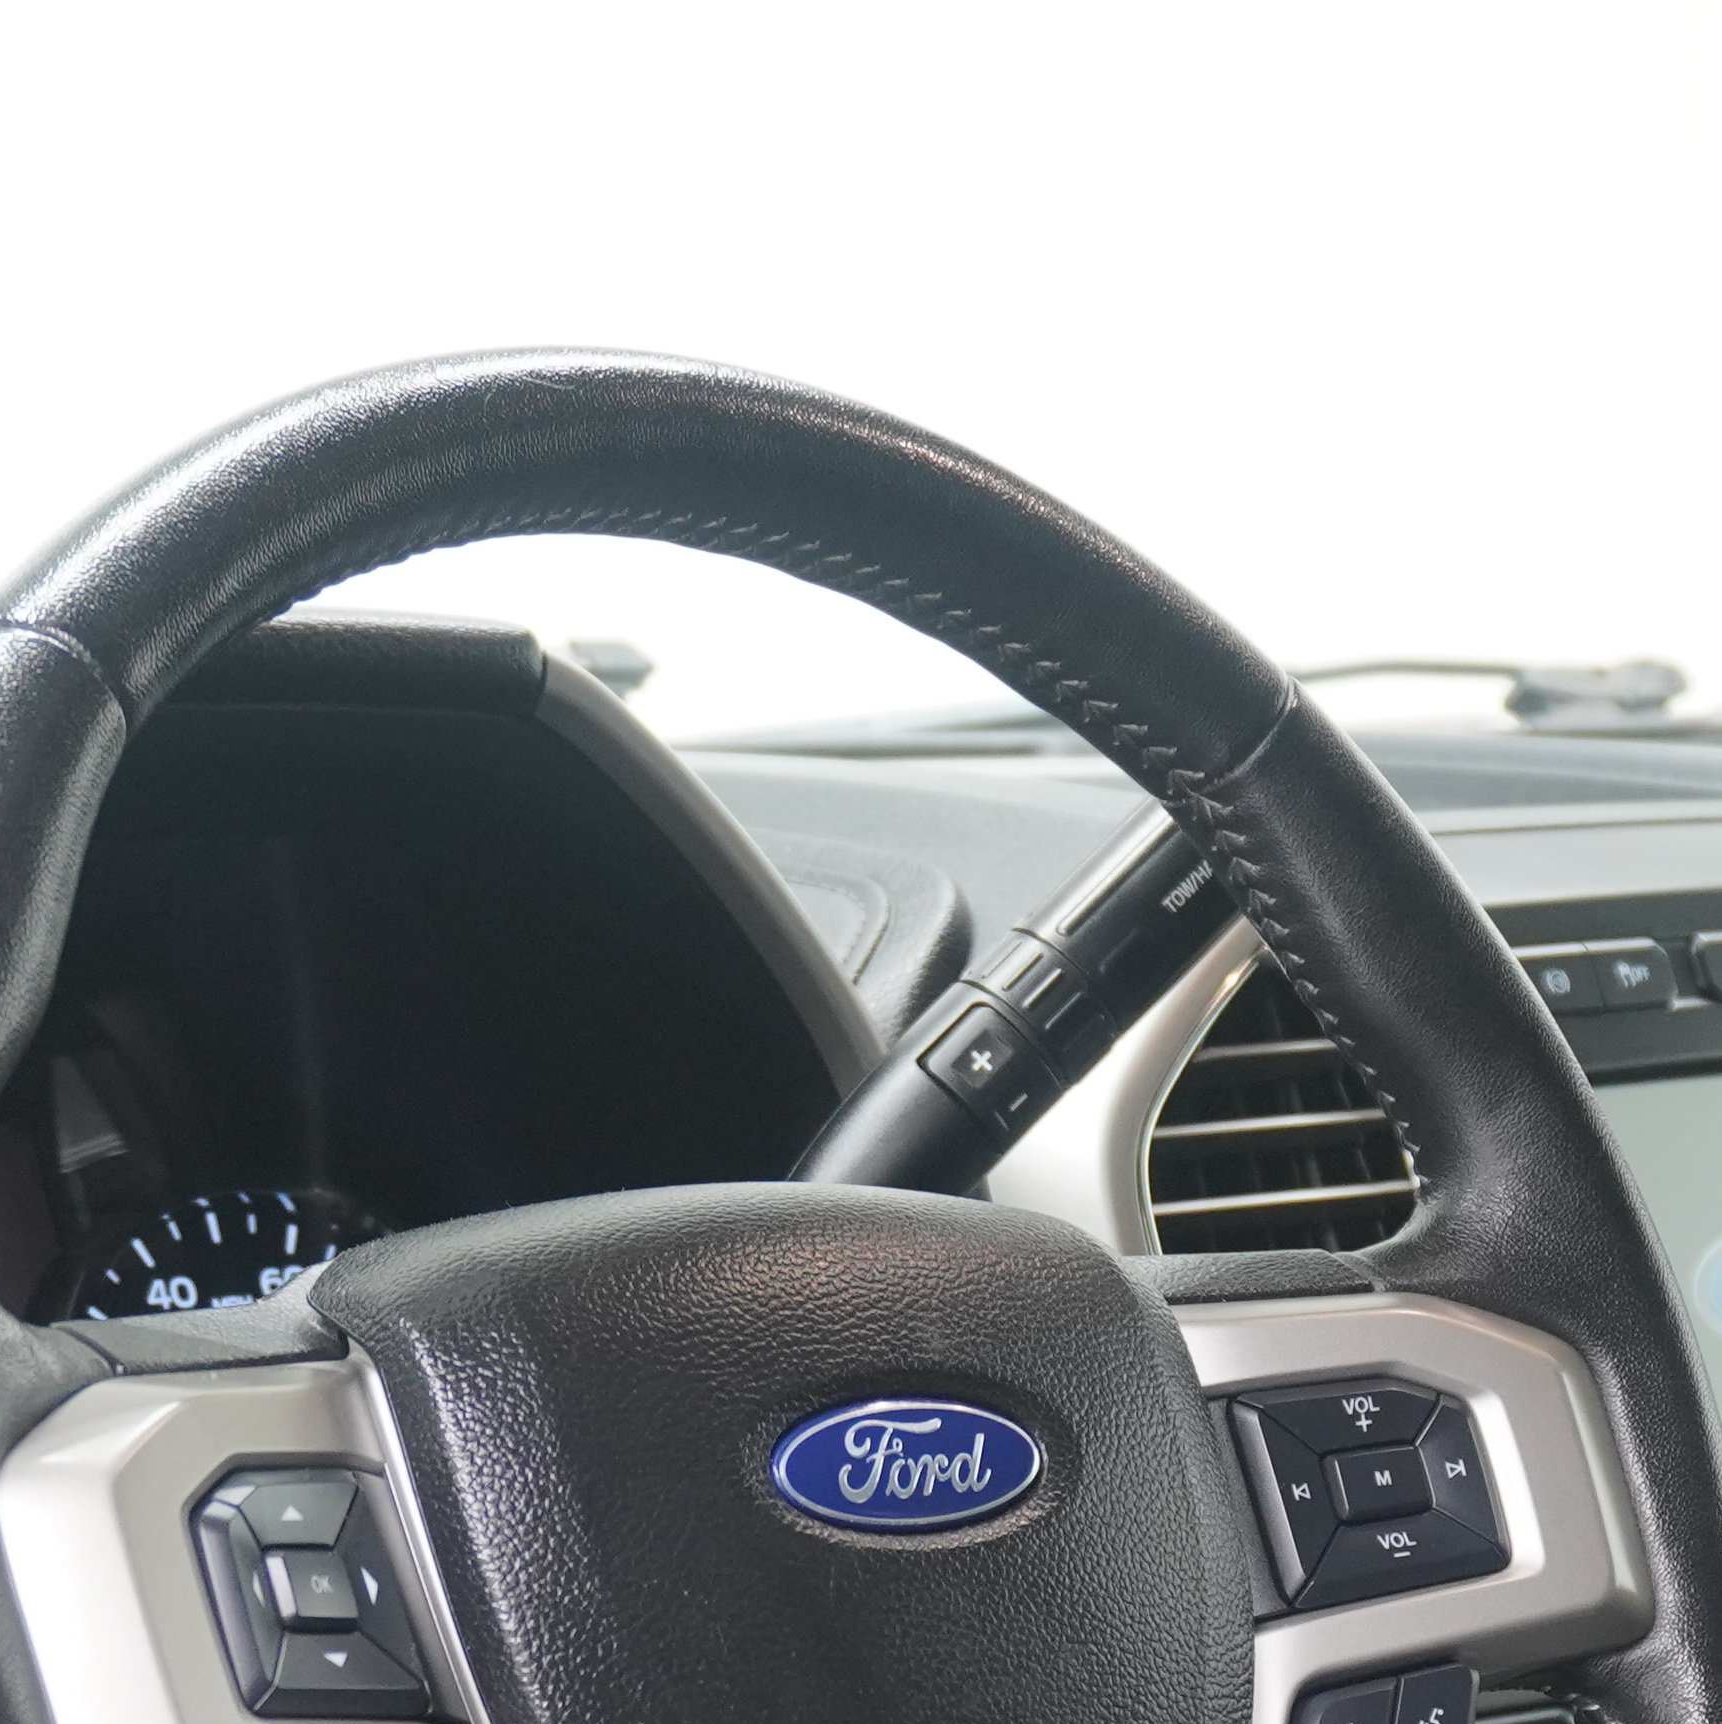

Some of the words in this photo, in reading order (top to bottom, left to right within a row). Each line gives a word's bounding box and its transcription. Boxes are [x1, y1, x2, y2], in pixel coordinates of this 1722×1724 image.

[146, 1276, 198, 1311] 40
[1342, 1396, 1381, 1415] VOL
[838, 1418, 992, 1504] Ford
[1374, 1470, 1393, 1487] M
[1377, 1531, 1418, 1550] VOL
[310, 1574, 333, 1594] OK
